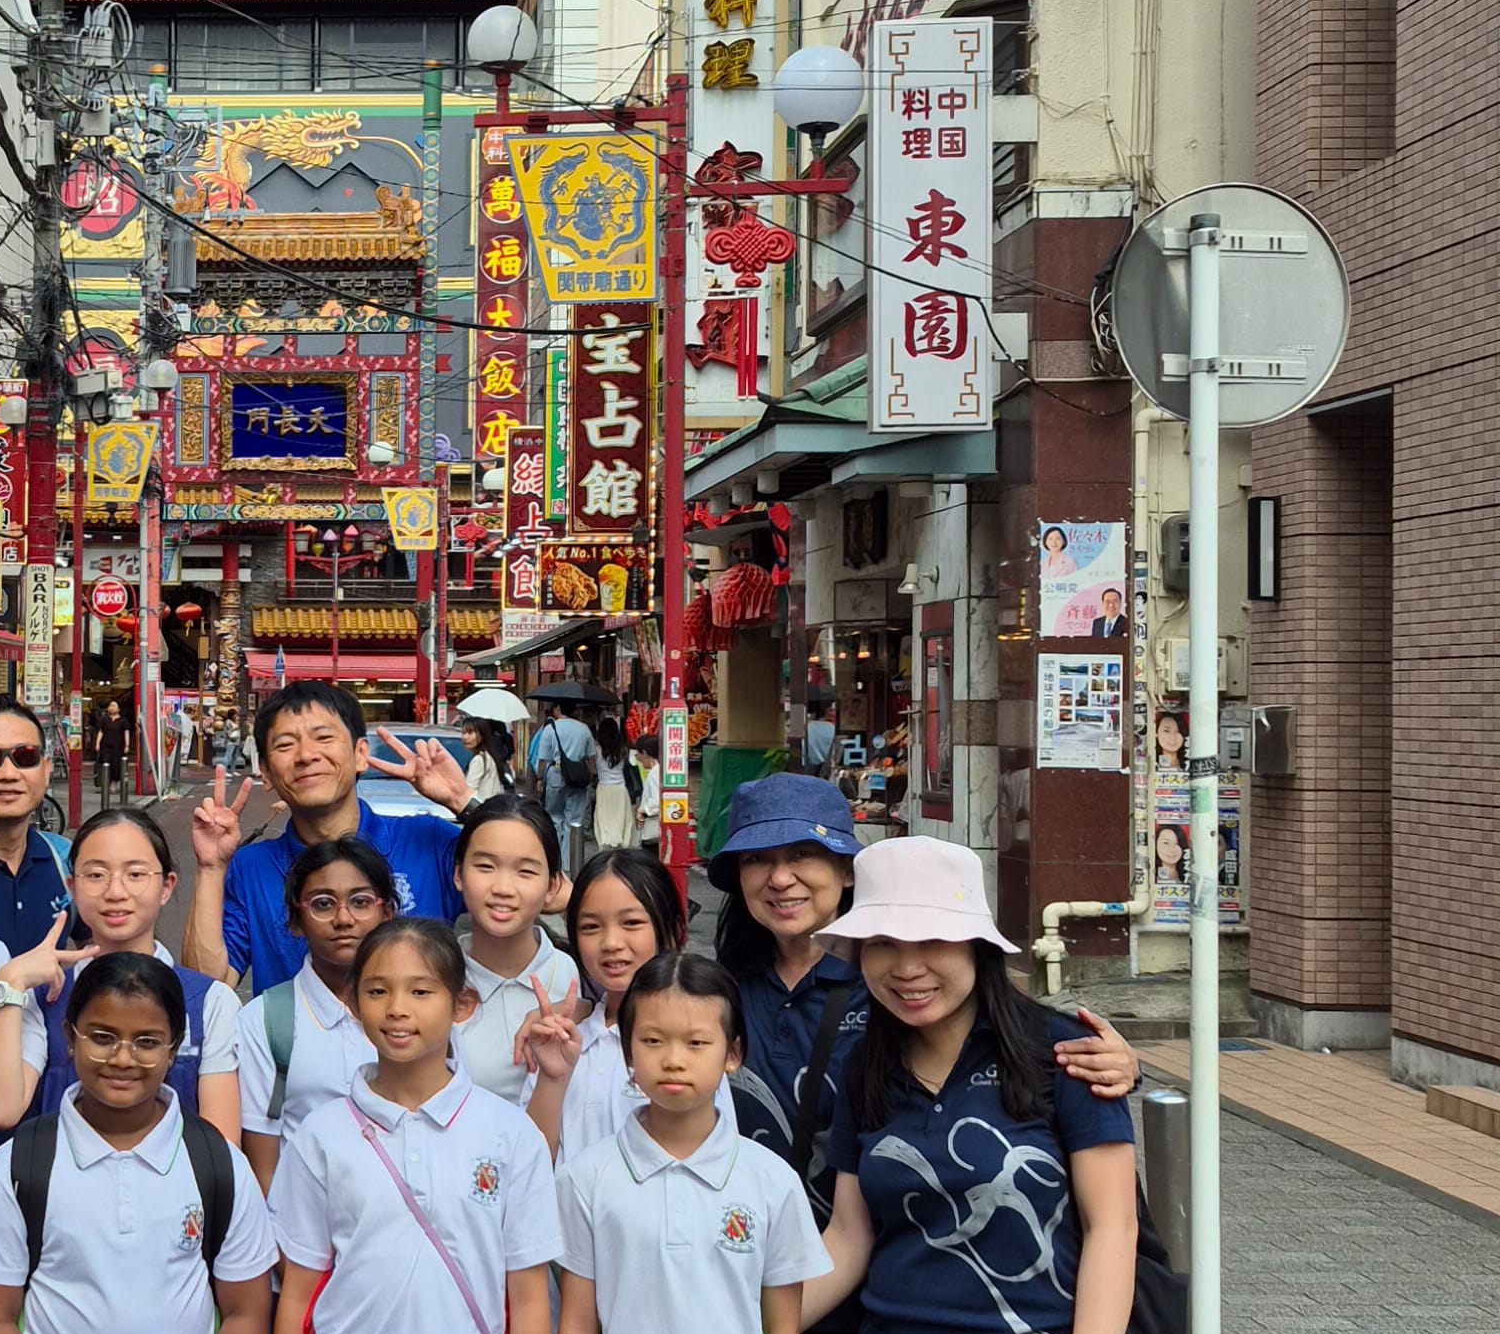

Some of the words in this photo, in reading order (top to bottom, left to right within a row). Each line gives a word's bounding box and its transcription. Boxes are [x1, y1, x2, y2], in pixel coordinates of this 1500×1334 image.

[557, 269, 646, 293] 関帝廟通り
[902, 188, 970, 362] 東園
[480, 176, 523, 456] 萬福大飯店
[579, 313, 644, 518] 宝占館
[570, 547, 597, 559] No.1
[33, 574, 47, 604] BAR
[1044, 582, 1078, 593] 公明党
